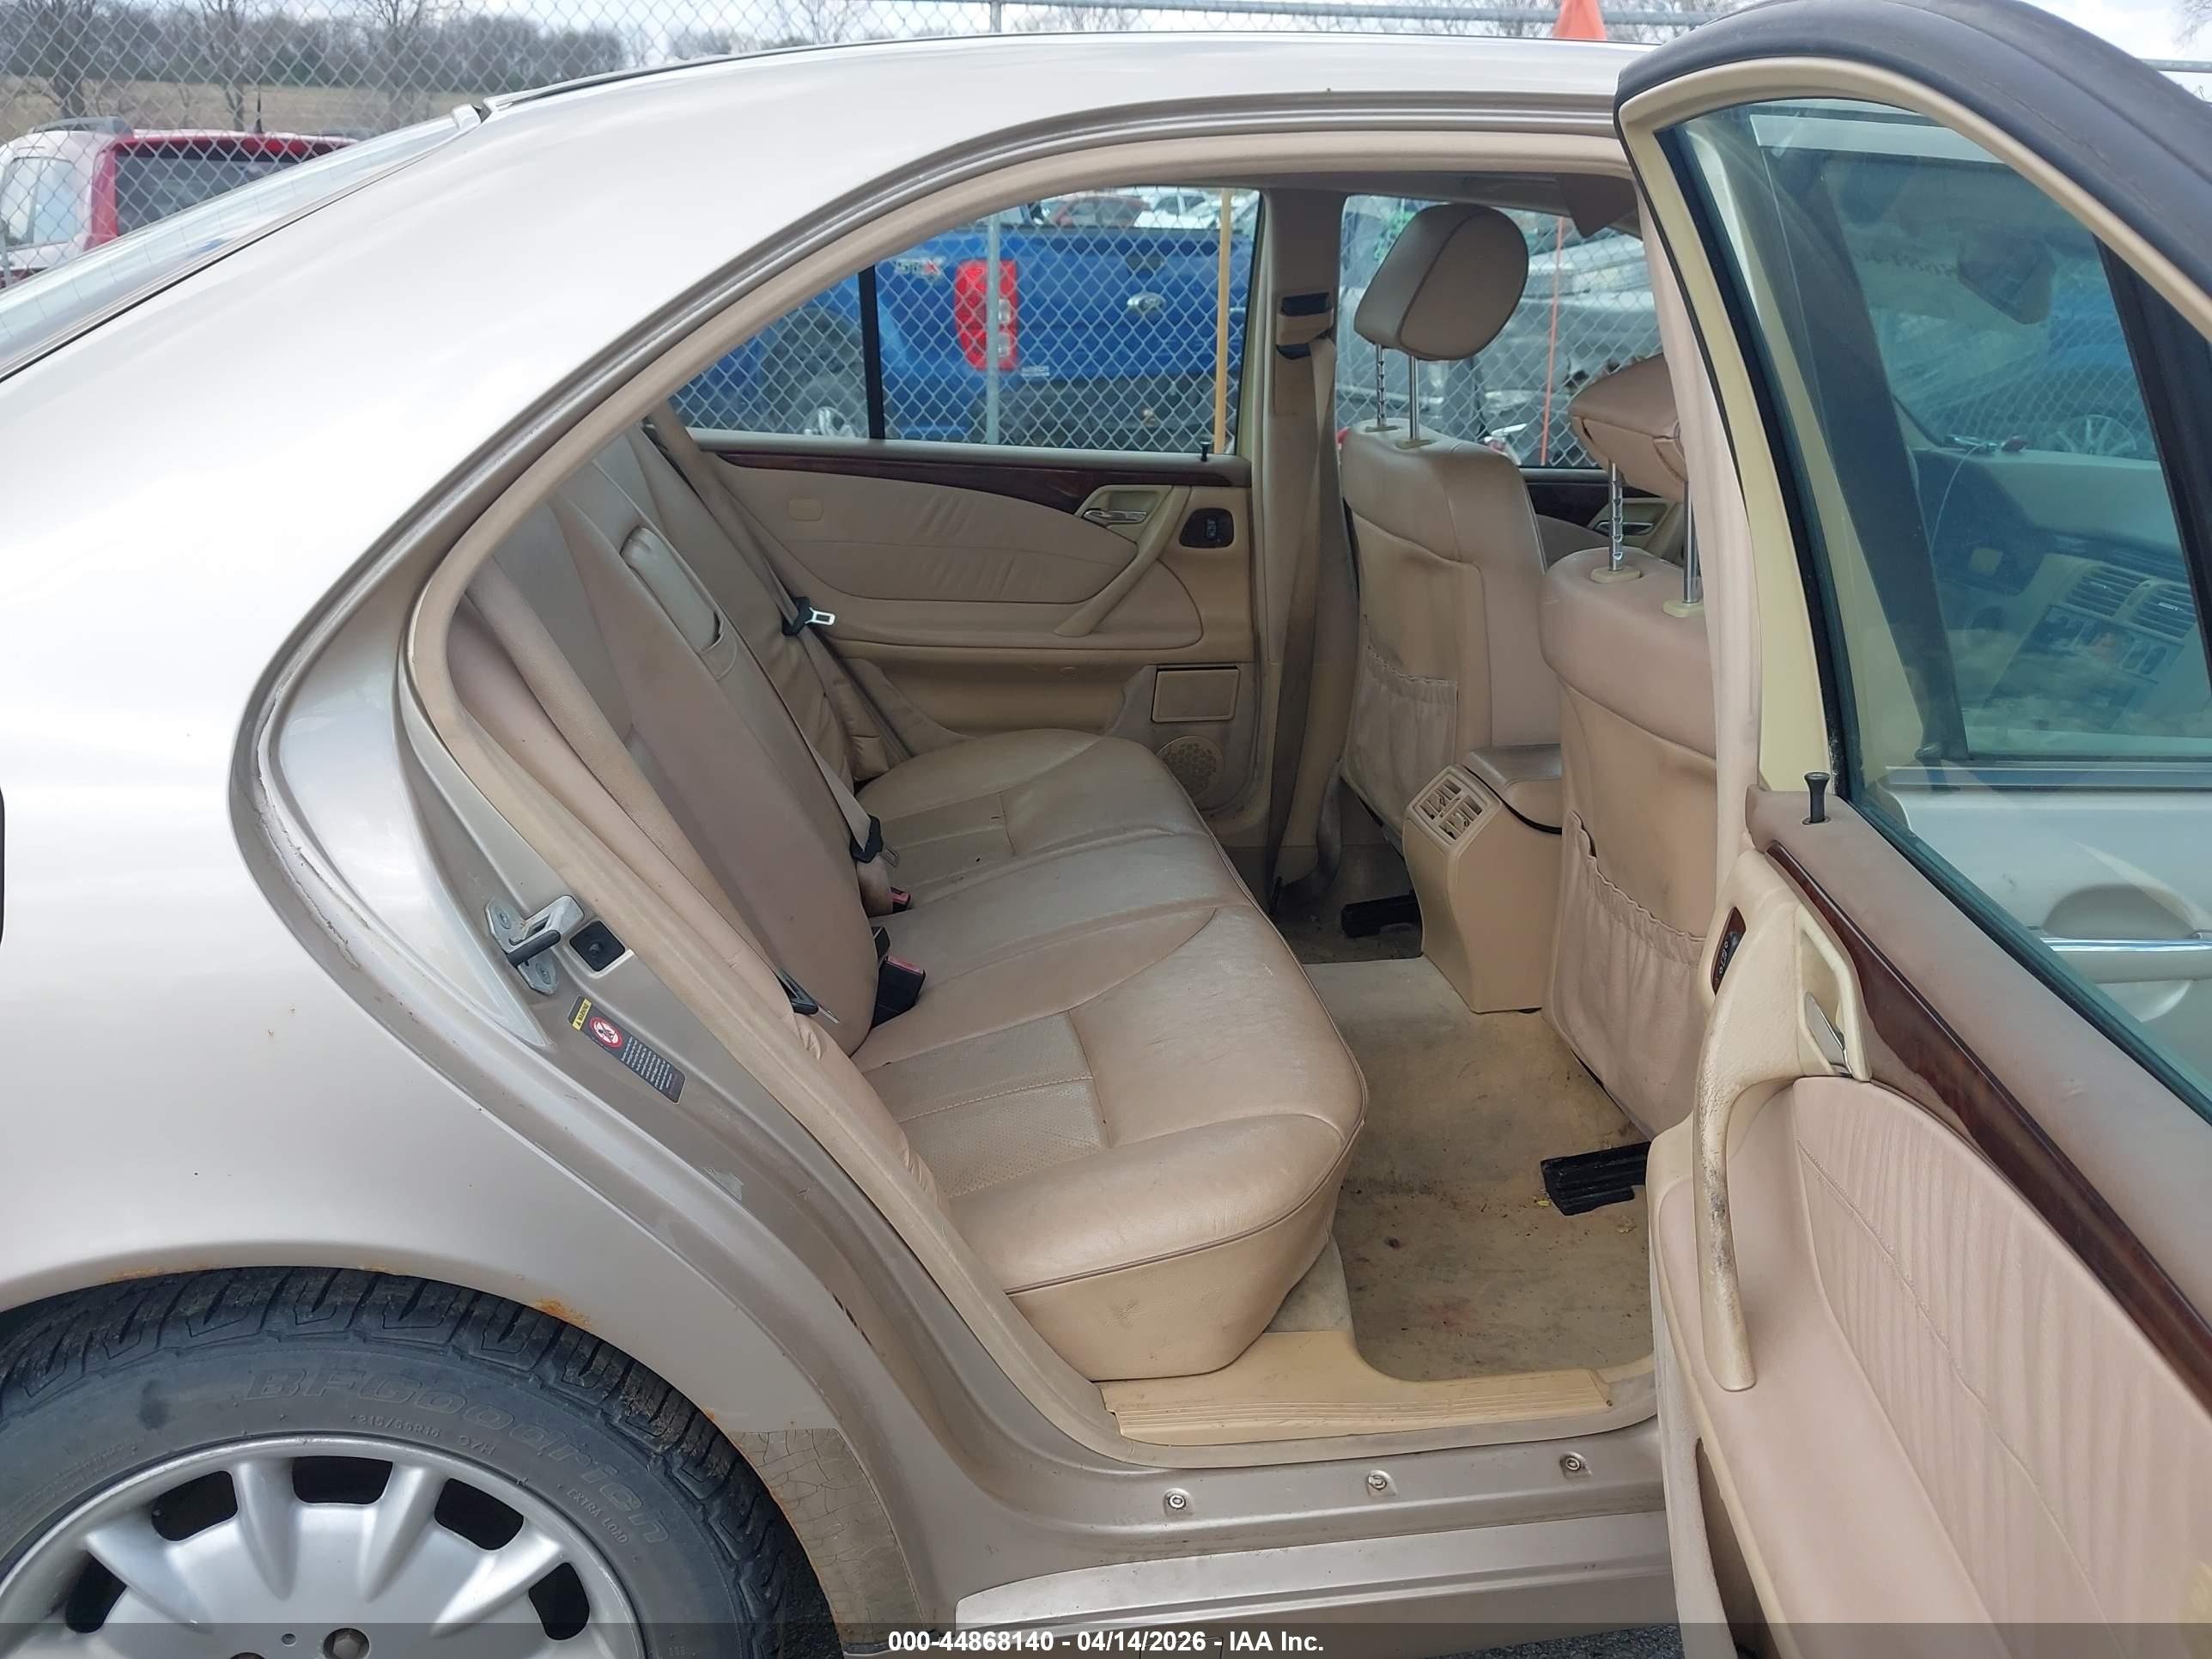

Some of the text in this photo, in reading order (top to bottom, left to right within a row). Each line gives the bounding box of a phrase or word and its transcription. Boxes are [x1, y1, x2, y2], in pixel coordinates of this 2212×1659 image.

[245, 1369, 669, 1544] BFGoodrich
[459, 1435, 496, 1456] 97H
[567, 1489, 628, 1543] EXTRA LOAD
